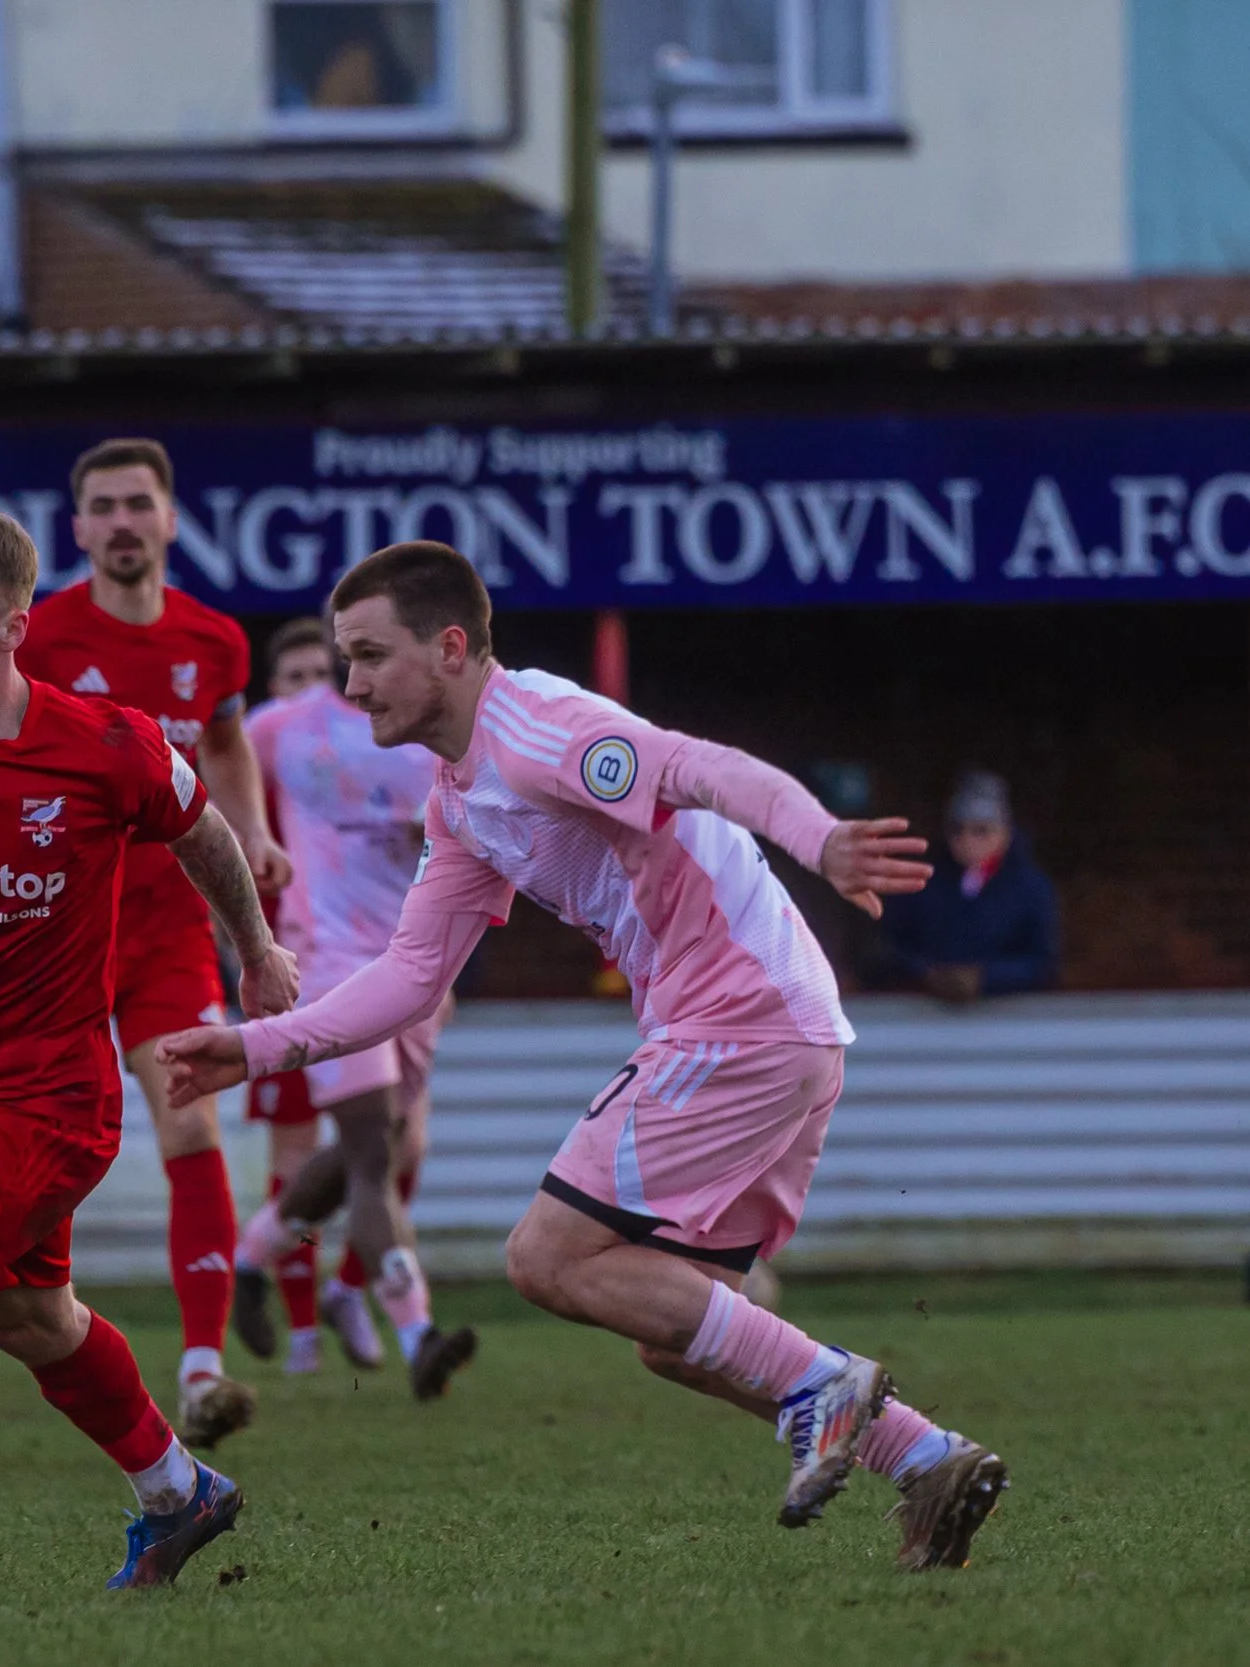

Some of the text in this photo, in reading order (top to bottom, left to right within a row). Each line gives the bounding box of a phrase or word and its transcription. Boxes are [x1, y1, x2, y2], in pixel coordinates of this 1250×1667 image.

[315, 427, 726, 484] Proudly Supporting
[598, 478, 980, 584] TOWN
[597, 755, 621, 783] B
